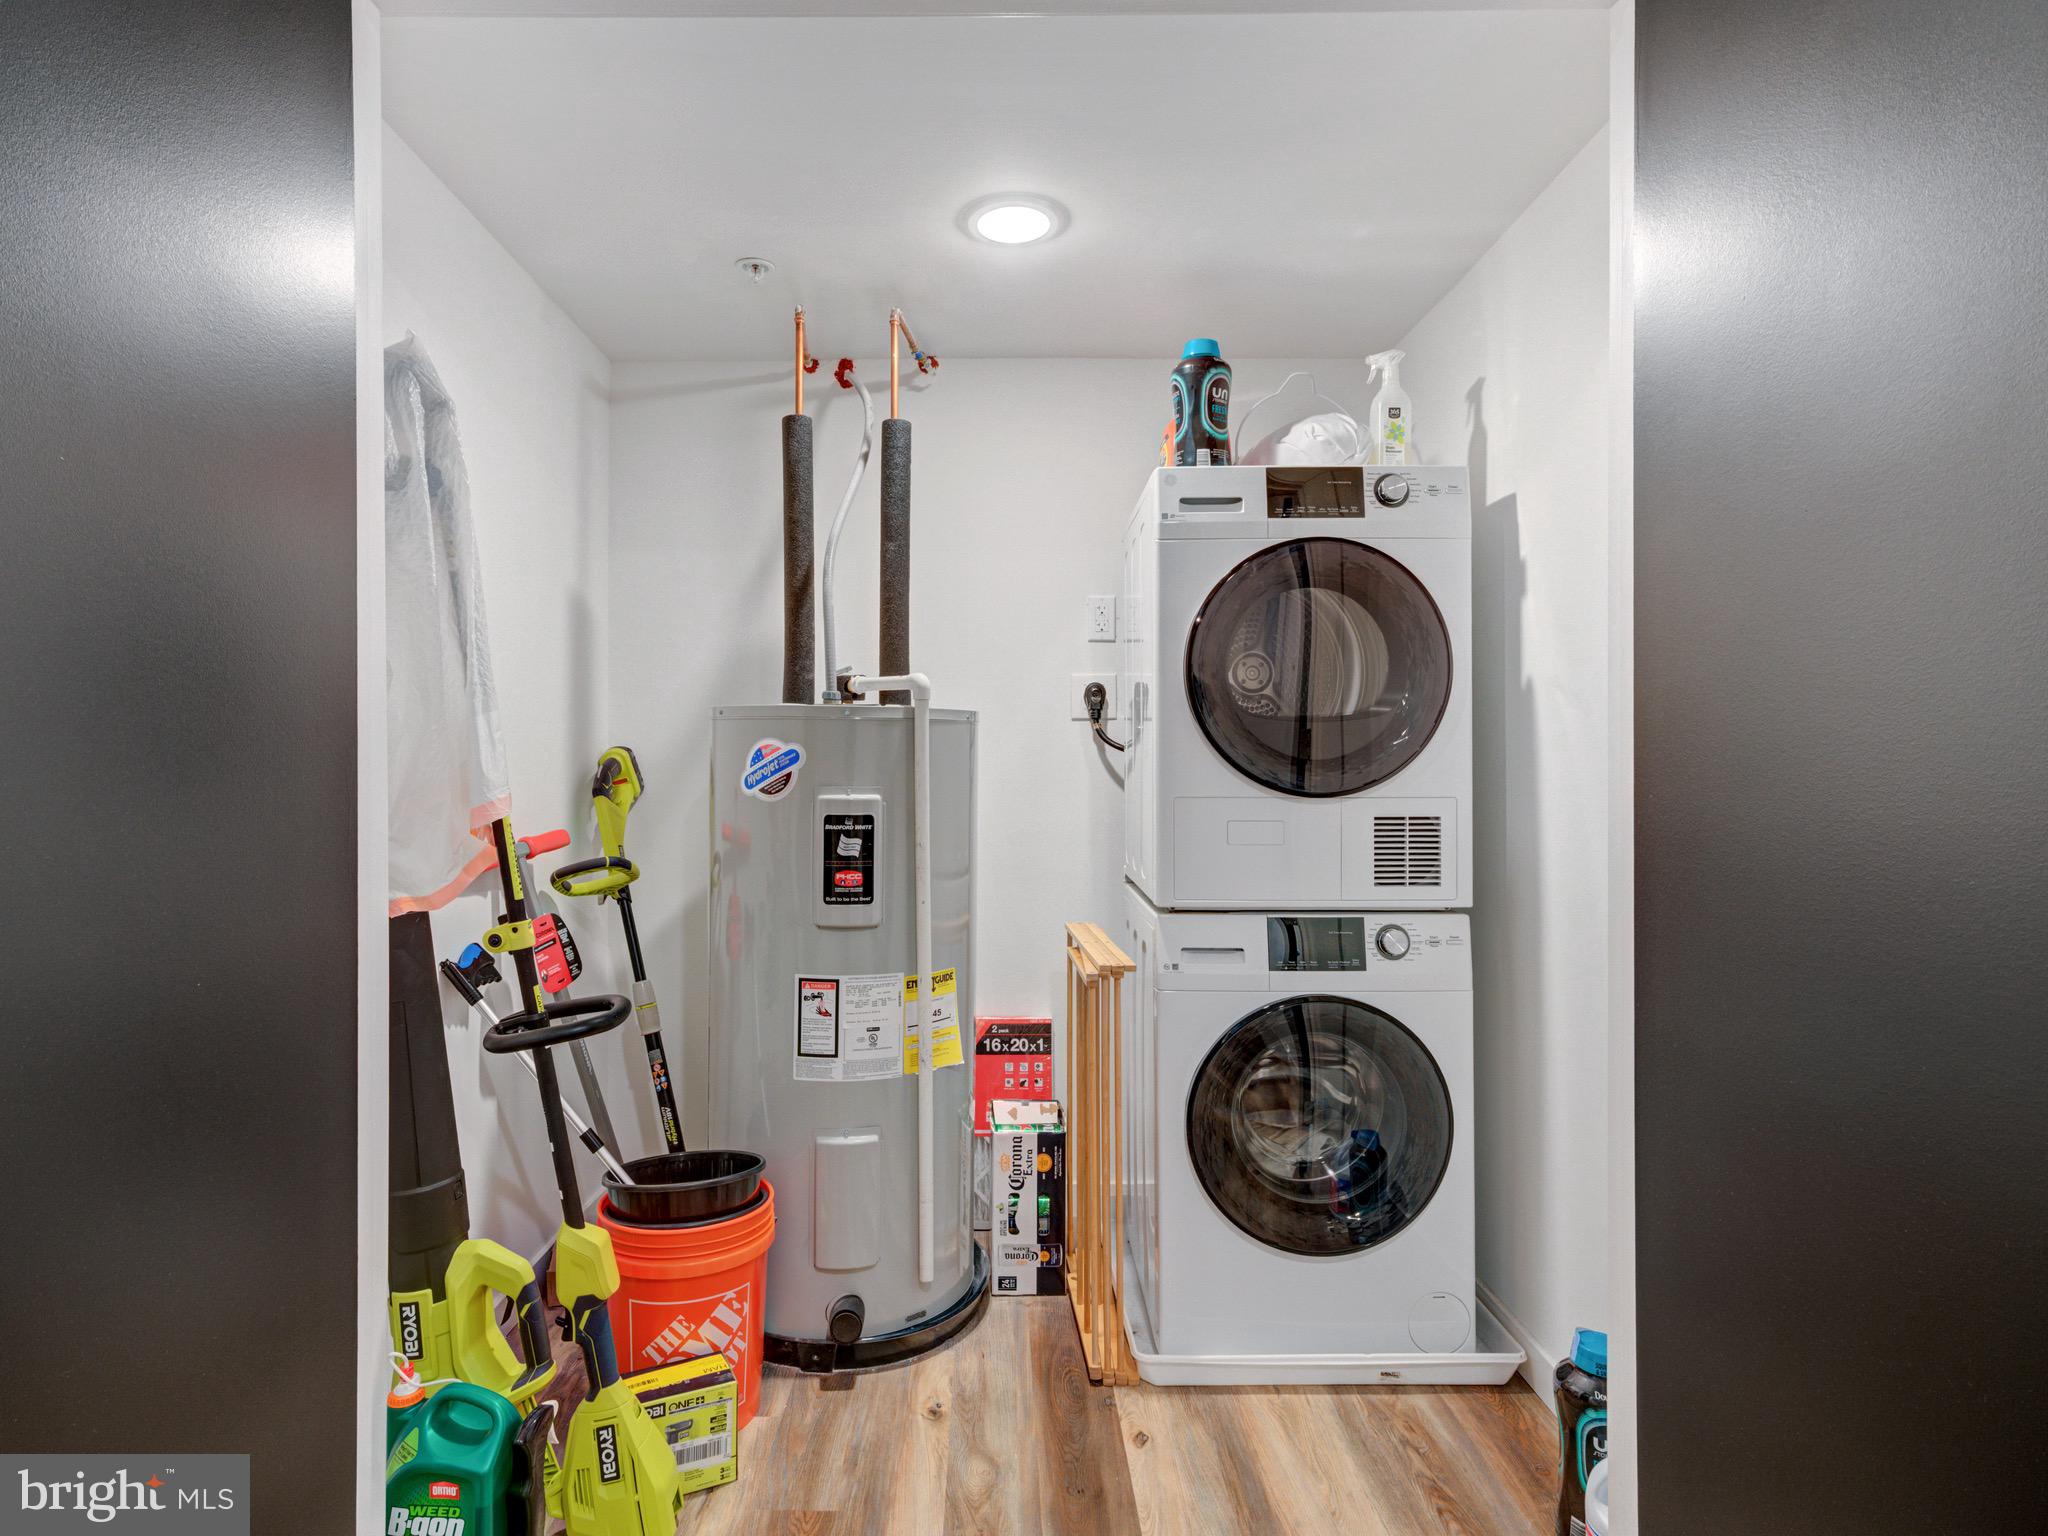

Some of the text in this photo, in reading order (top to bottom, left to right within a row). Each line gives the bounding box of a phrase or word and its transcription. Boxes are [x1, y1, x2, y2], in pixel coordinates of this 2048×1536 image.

[747, 758, 780, 786] Hydrojet
[991, 1024, 998, 1034] 2
[1008, 1136, 1026, 1190] Corona
[1022, 1149, 1033, 1176] Extra
[1004, 1251, 1039, 1262] Corona
[1001, 1279, 1010, 1289] 24
[402, 1304, 419, 1357] RYOBI
[641, 1314, 697, 1365] THE
[598, 1427, 617, 1479] RYOBI
[432, 1485, 458, 1496] ORTHO
[409, 1505, 461, 1518] WEED
